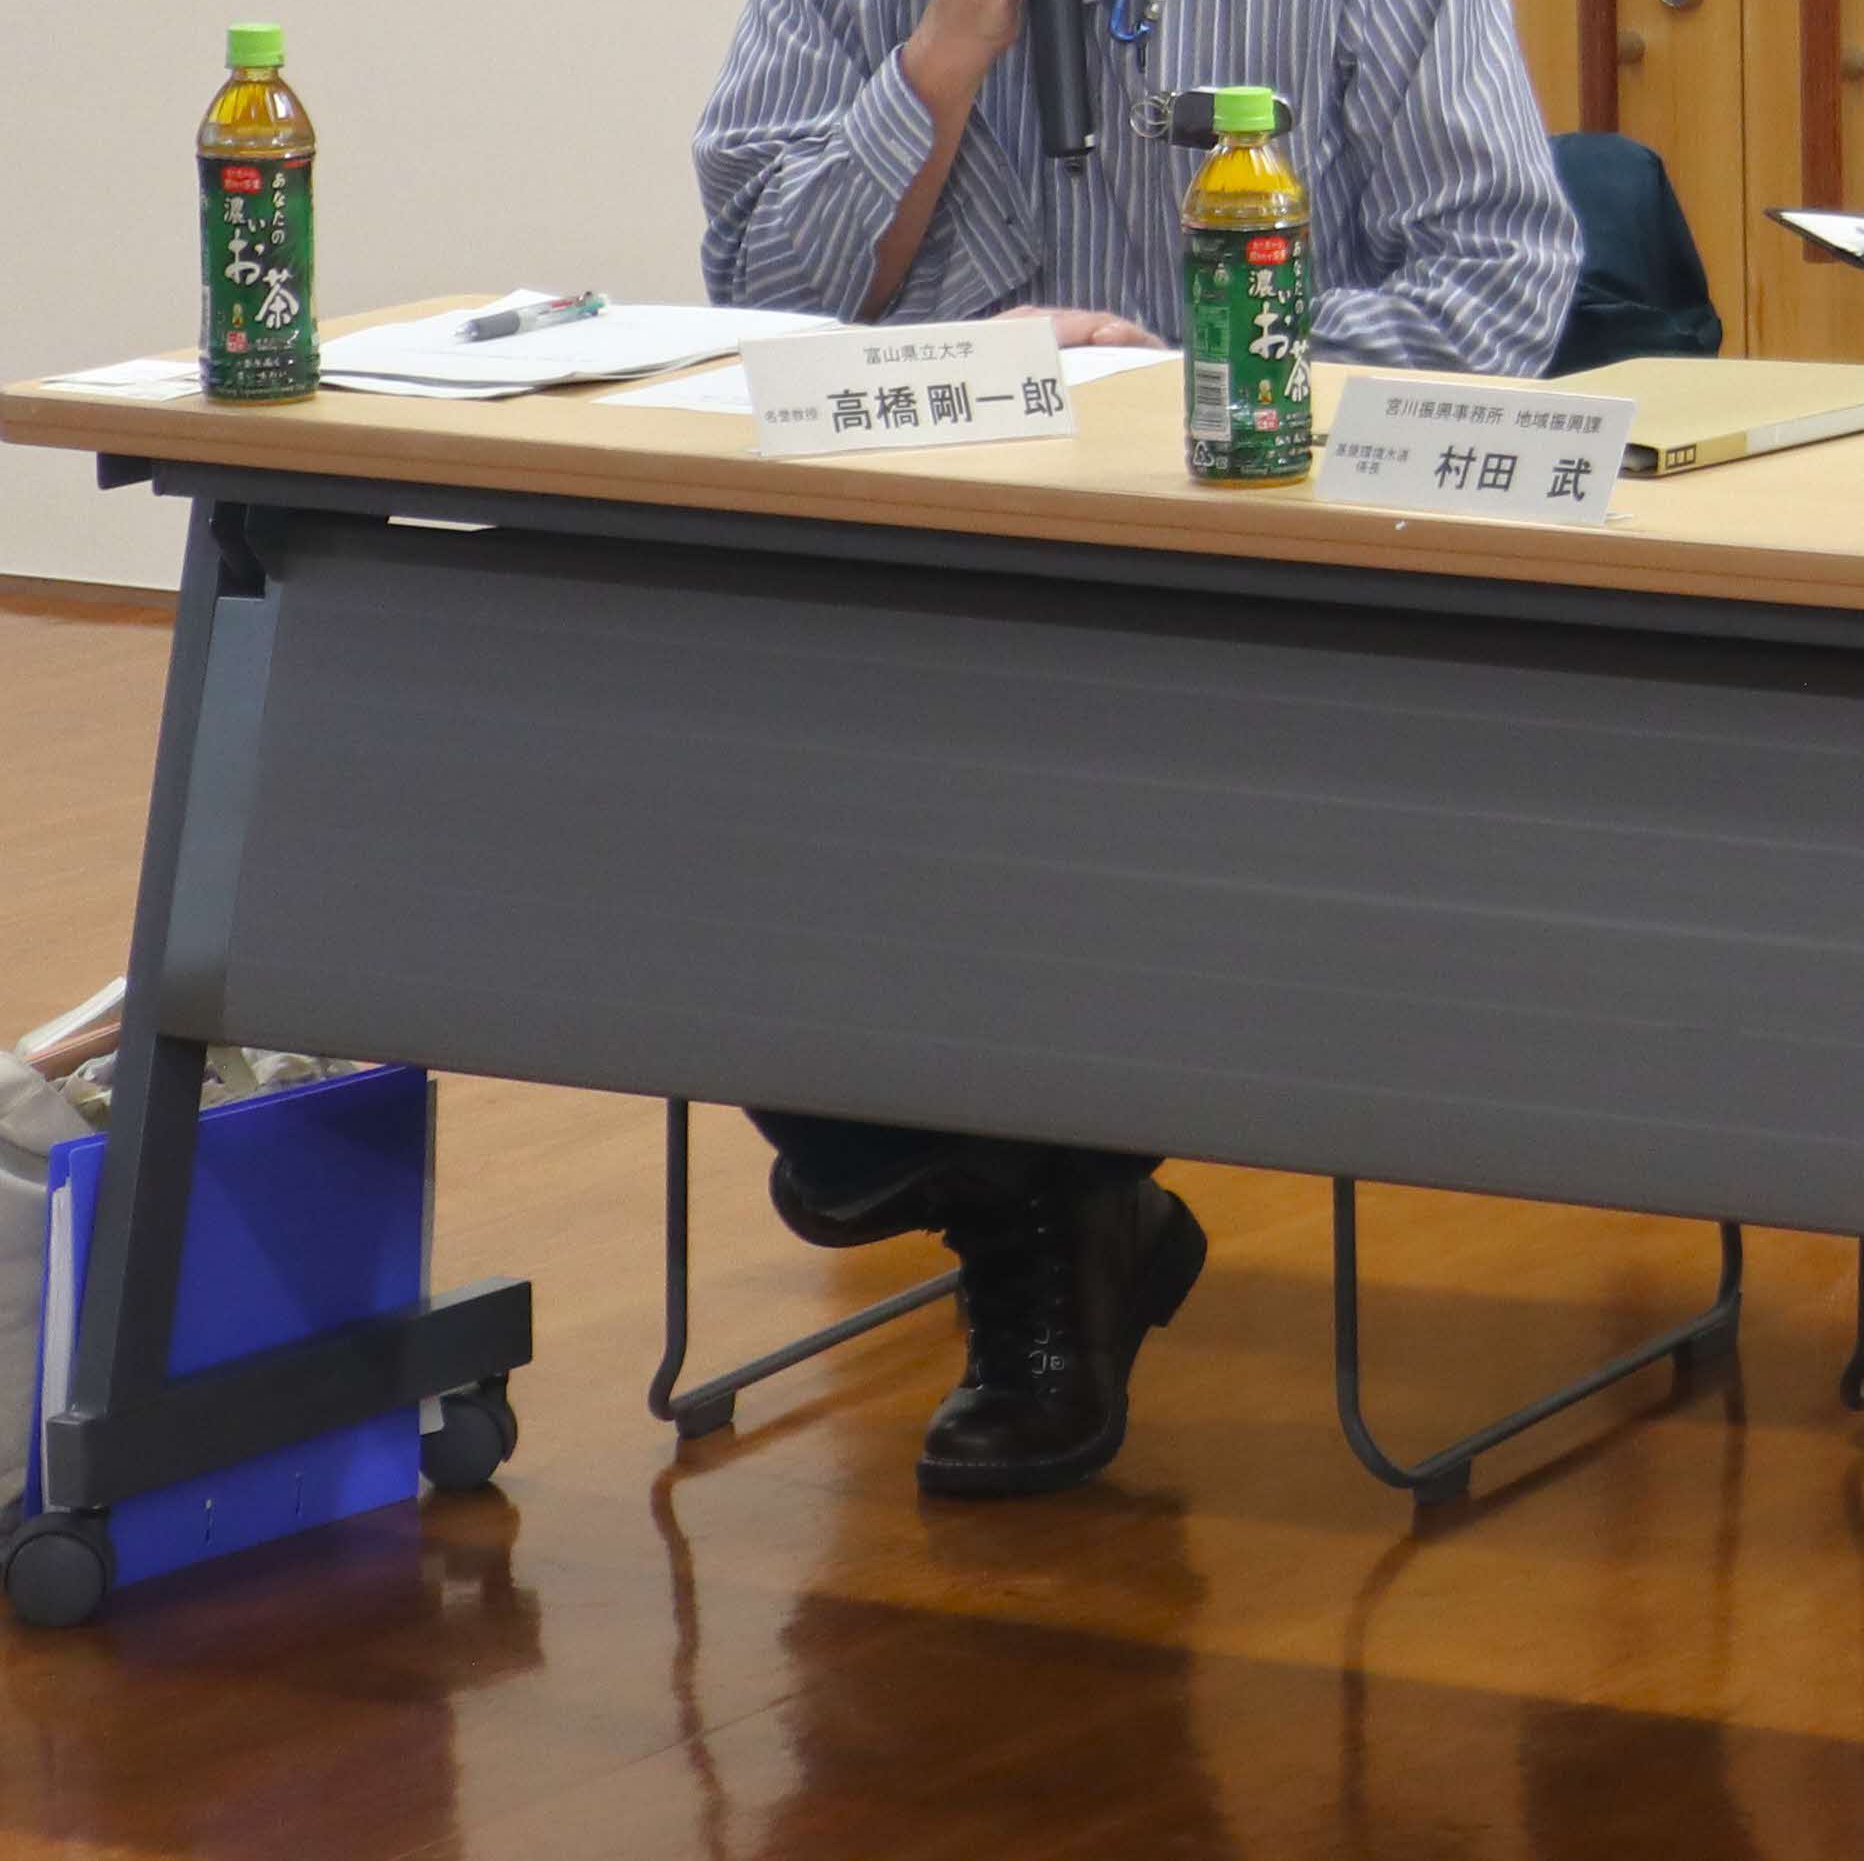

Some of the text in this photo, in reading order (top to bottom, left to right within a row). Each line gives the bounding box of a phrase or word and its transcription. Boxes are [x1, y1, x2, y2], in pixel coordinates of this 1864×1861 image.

[271, 172, 286, 245] あなたの
[863, 341, 974, 365] 富山県立大学
[827, 376, 1064, 433] 高橋剛一郎
[1384, 397, 1602, 435] 宮川振興事務所 地域振興課
[1433, 444, 1593, 502] 村田 武
